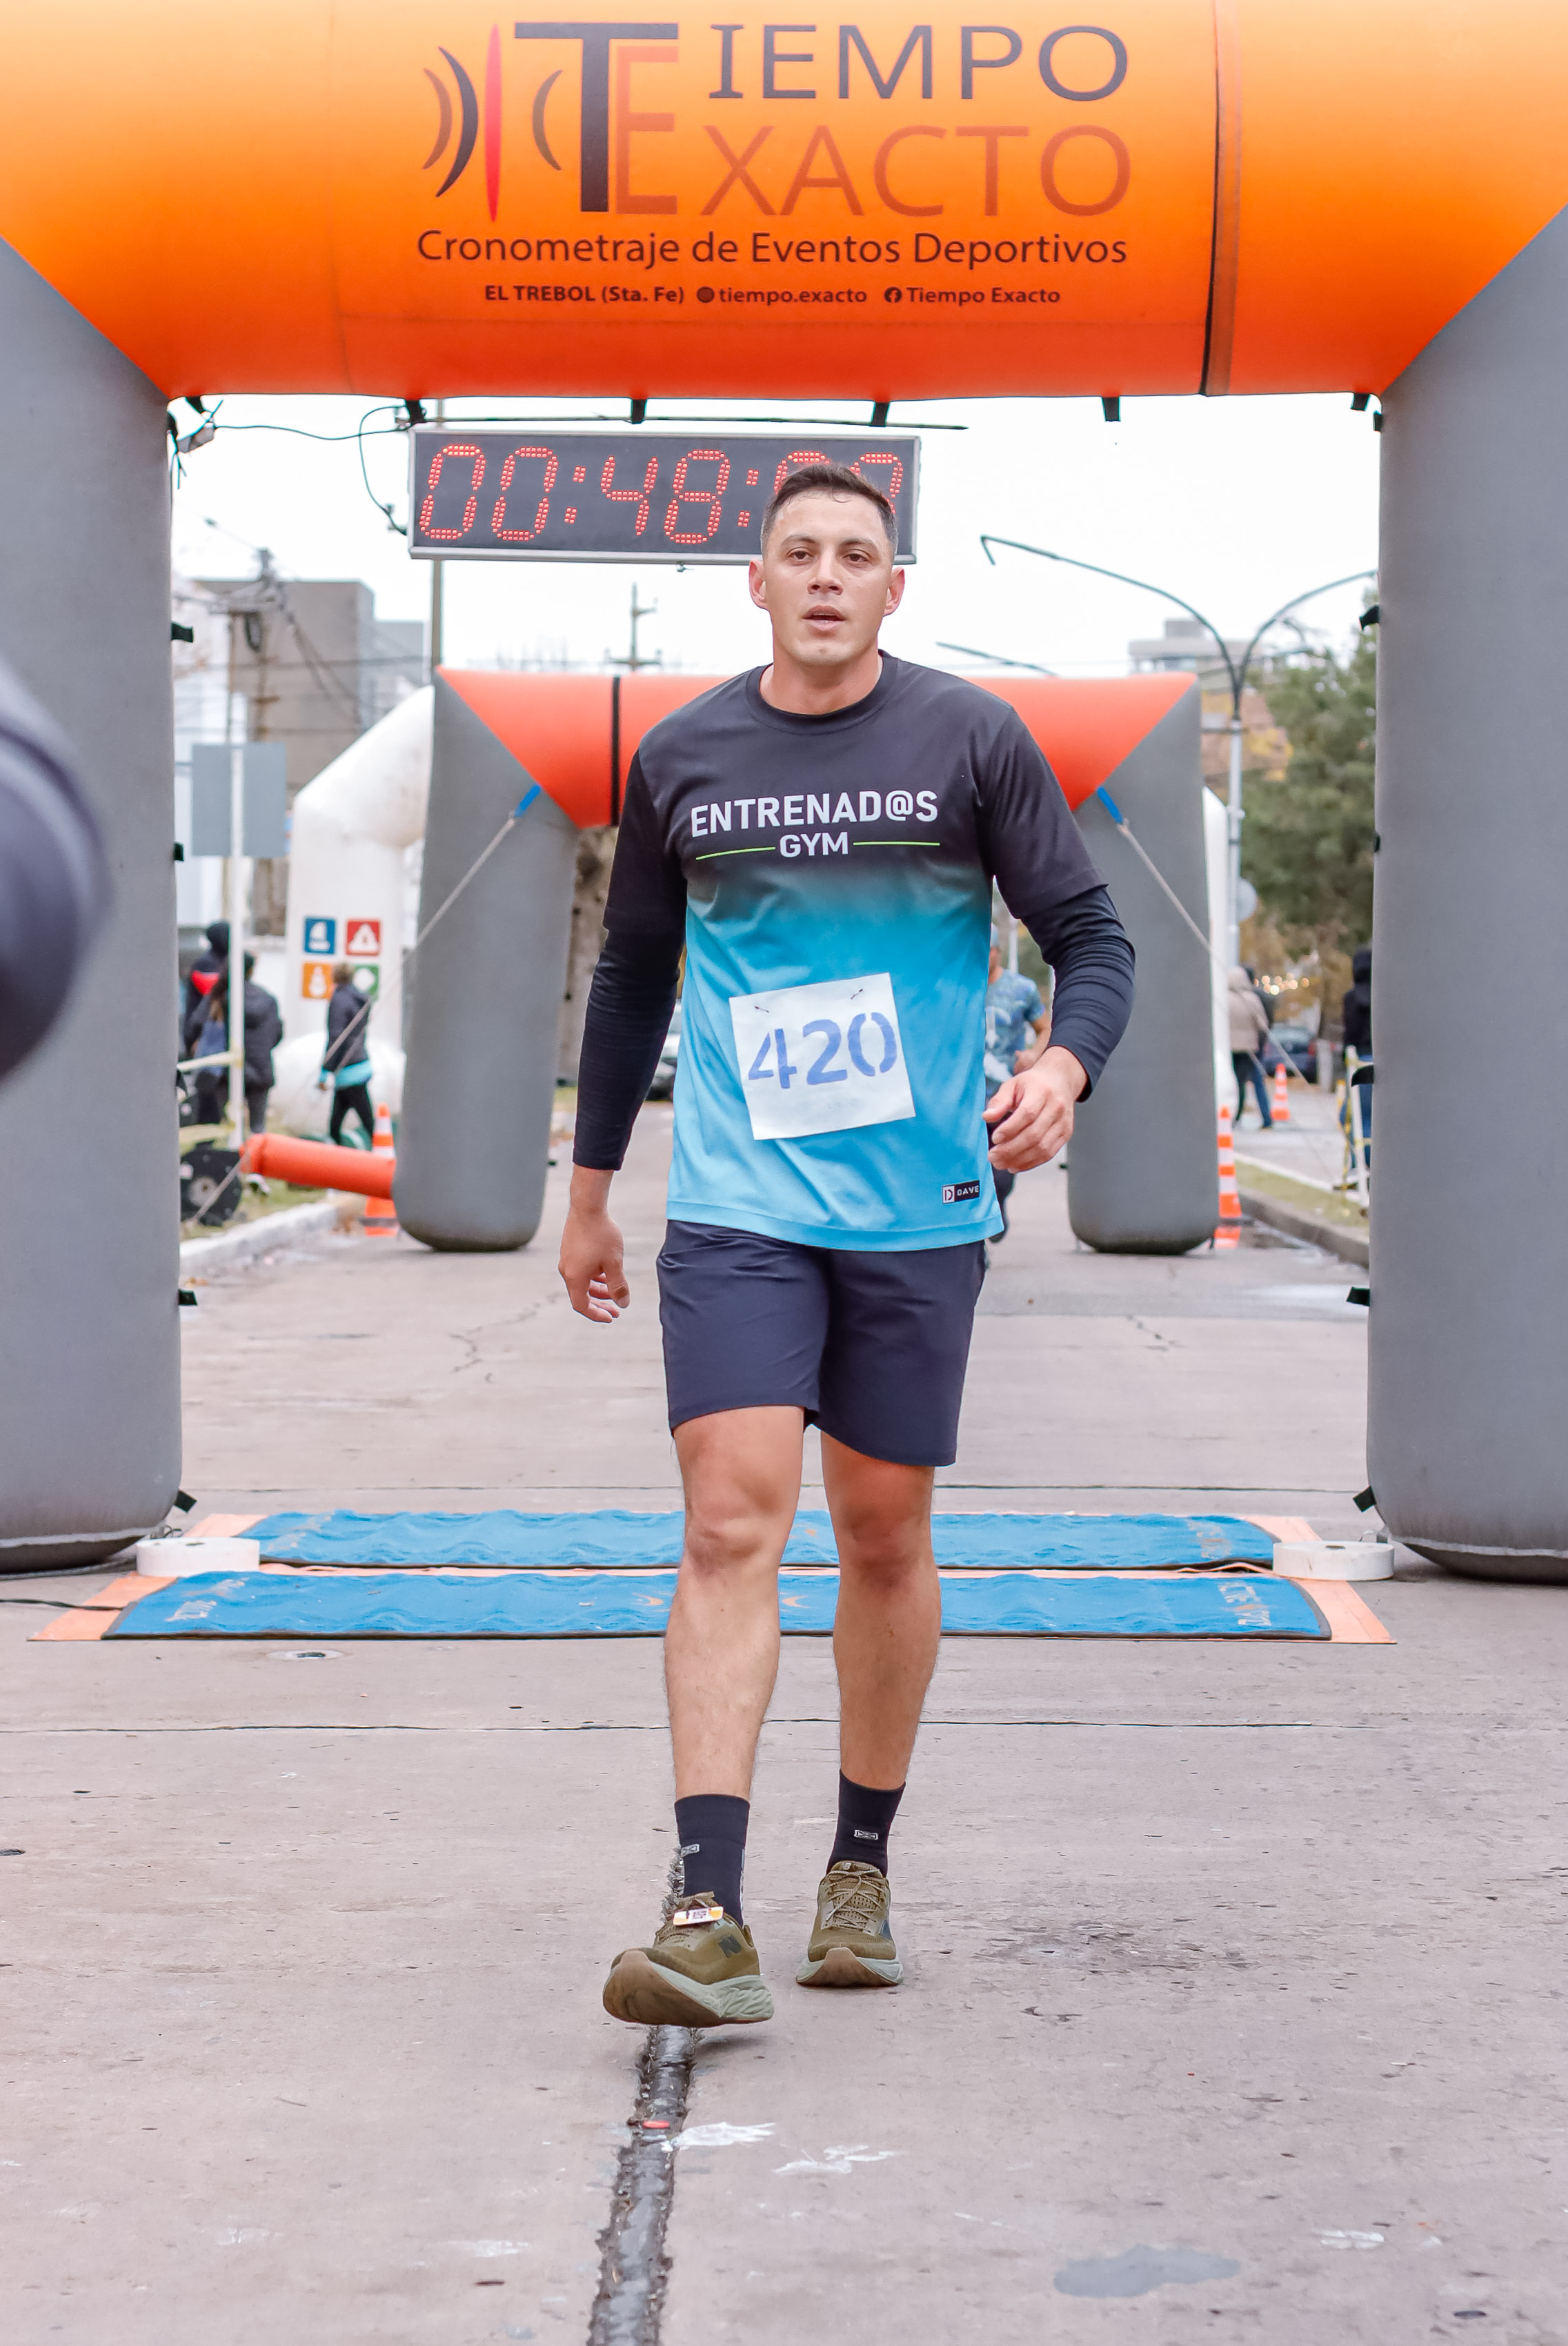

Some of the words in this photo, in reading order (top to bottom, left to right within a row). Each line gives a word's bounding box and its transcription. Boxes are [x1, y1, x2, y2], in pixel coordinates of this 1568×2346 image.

[417, 230, 679, 270] Cronometraje
[692, 230, 737, 262] de
[752, 232, 900, 263] Eventos
[914, 232, 1127, 270] Deportivos
[485, 285, 508, 301] EL
[513, 285, 595, 301] TREBOL
[602, 286, 648, 304] (Sta.
[653, 286, 684, 304] Fe)
[719, 287, 867, 306] tiempo.exacto
[906, 286, 985, 306] Tiempo
[991, 287, 1060, 302] Exacto
[691, 790, 939, 838] ENTRENAD@S
[779, 831, 848, 858] GYM
[748, 1012, 897, 1089] 420
